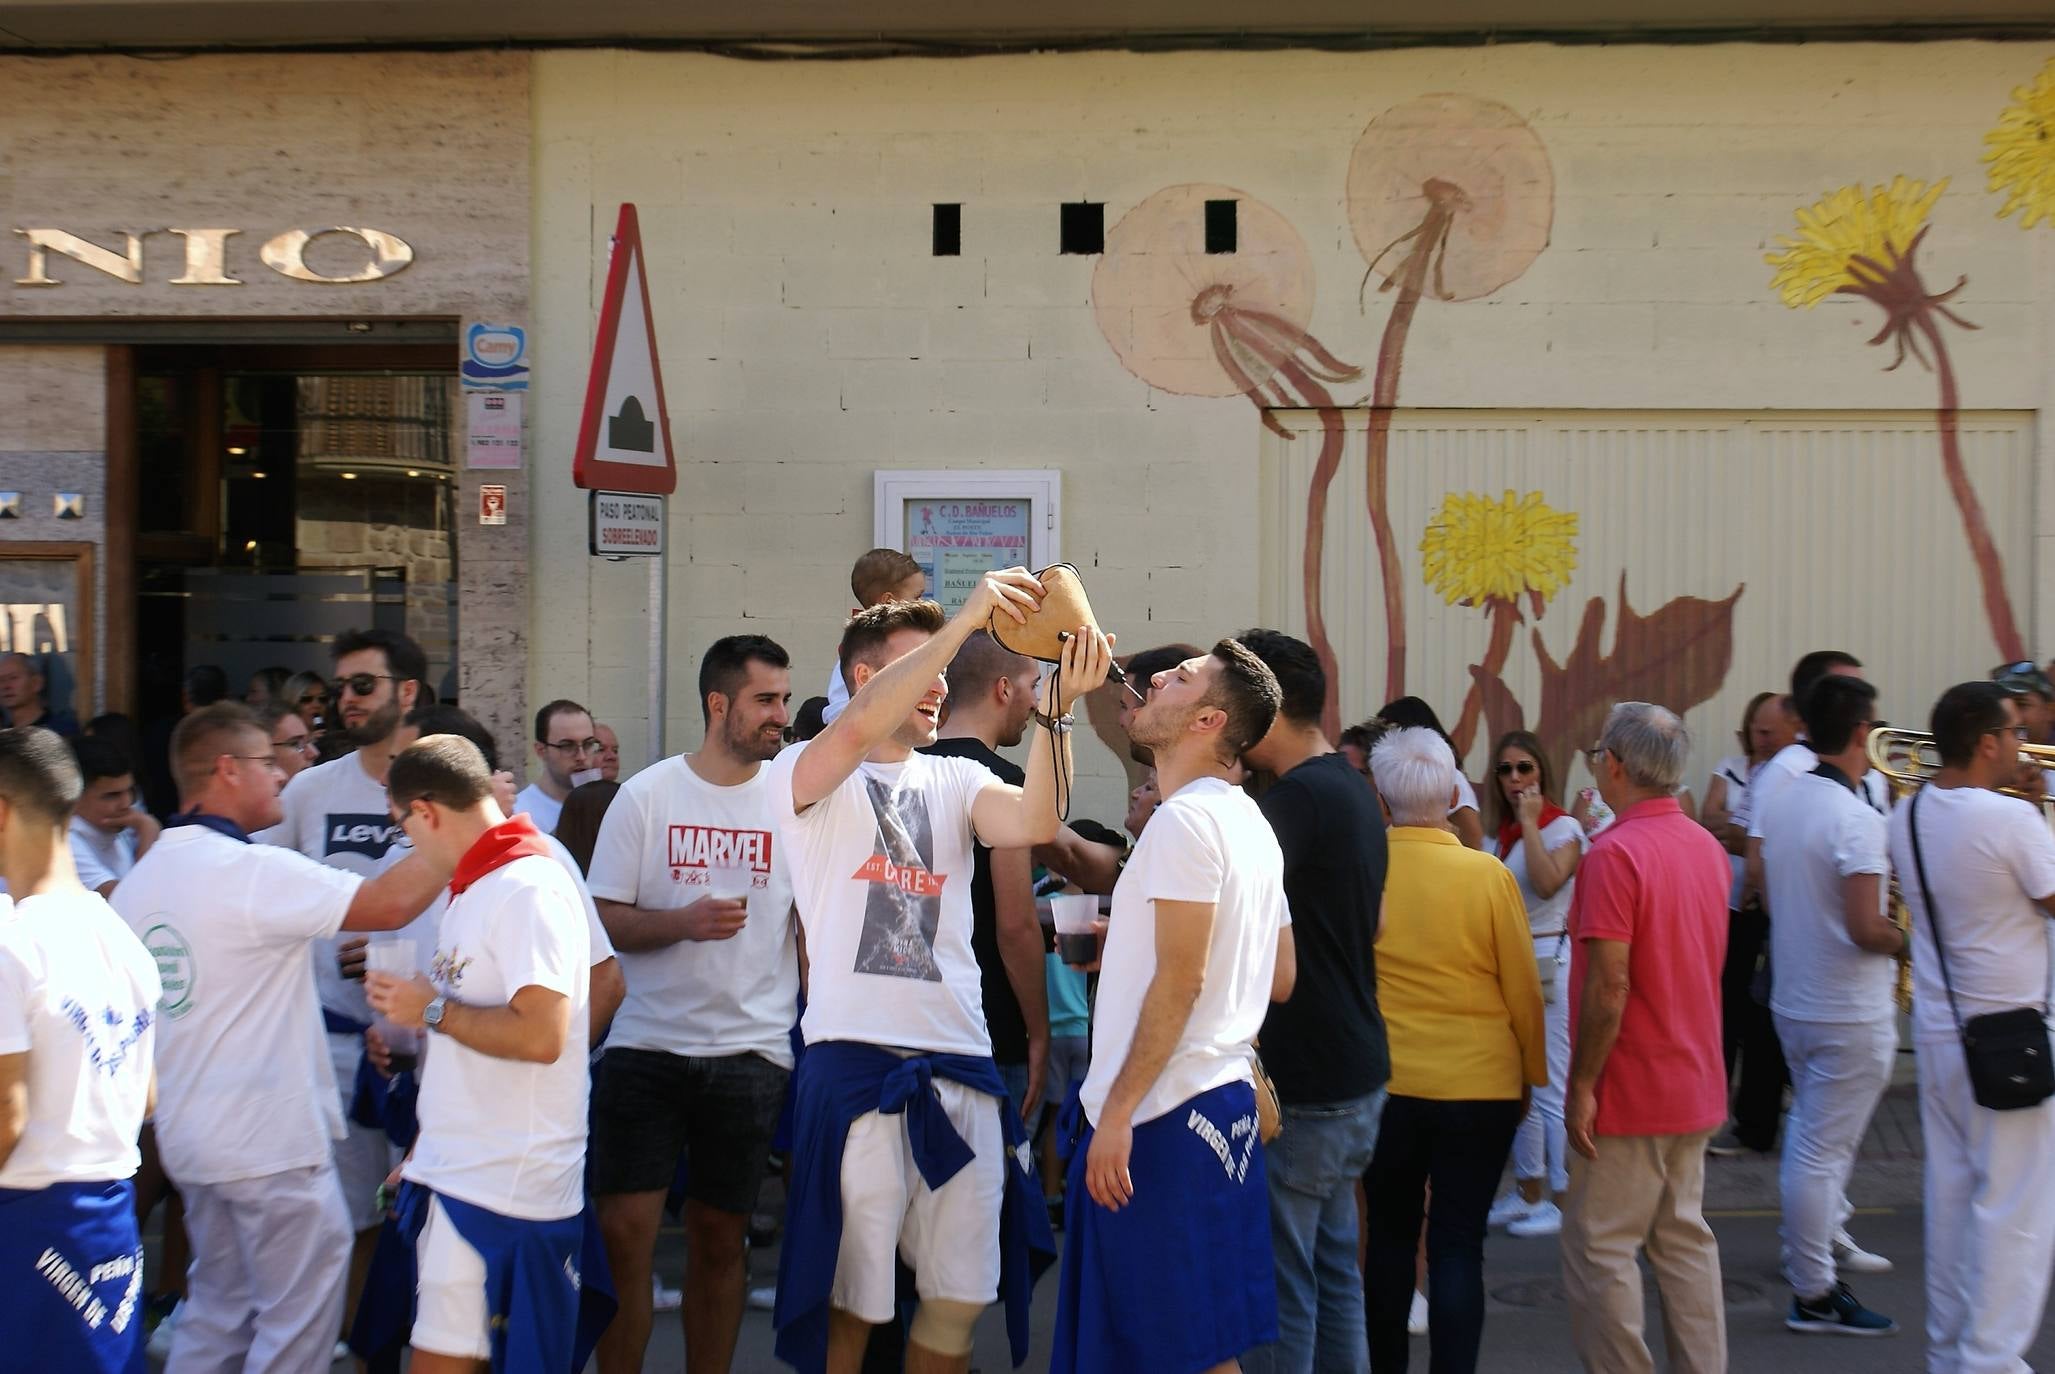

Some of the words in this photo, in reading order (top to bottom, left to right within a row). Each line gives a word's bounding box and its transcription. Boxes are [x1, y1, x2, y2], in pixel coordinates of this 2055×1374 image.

[13, 225, 415, 284] NIO
[476, 338, 516, 357] Camy
[600, 502, 619, 519] PASO
[623, 503, 659, 521] PEATONAL
[602, 527, 656, 545] SOBREELEVADO
[670, 827, 770, 871] MARVEL
[1187, 1108, 1231, 1165] VIRGEN
[35, 1246, 93, 1311] VIRGEN
[82, 1296, 109, 1330] DE
